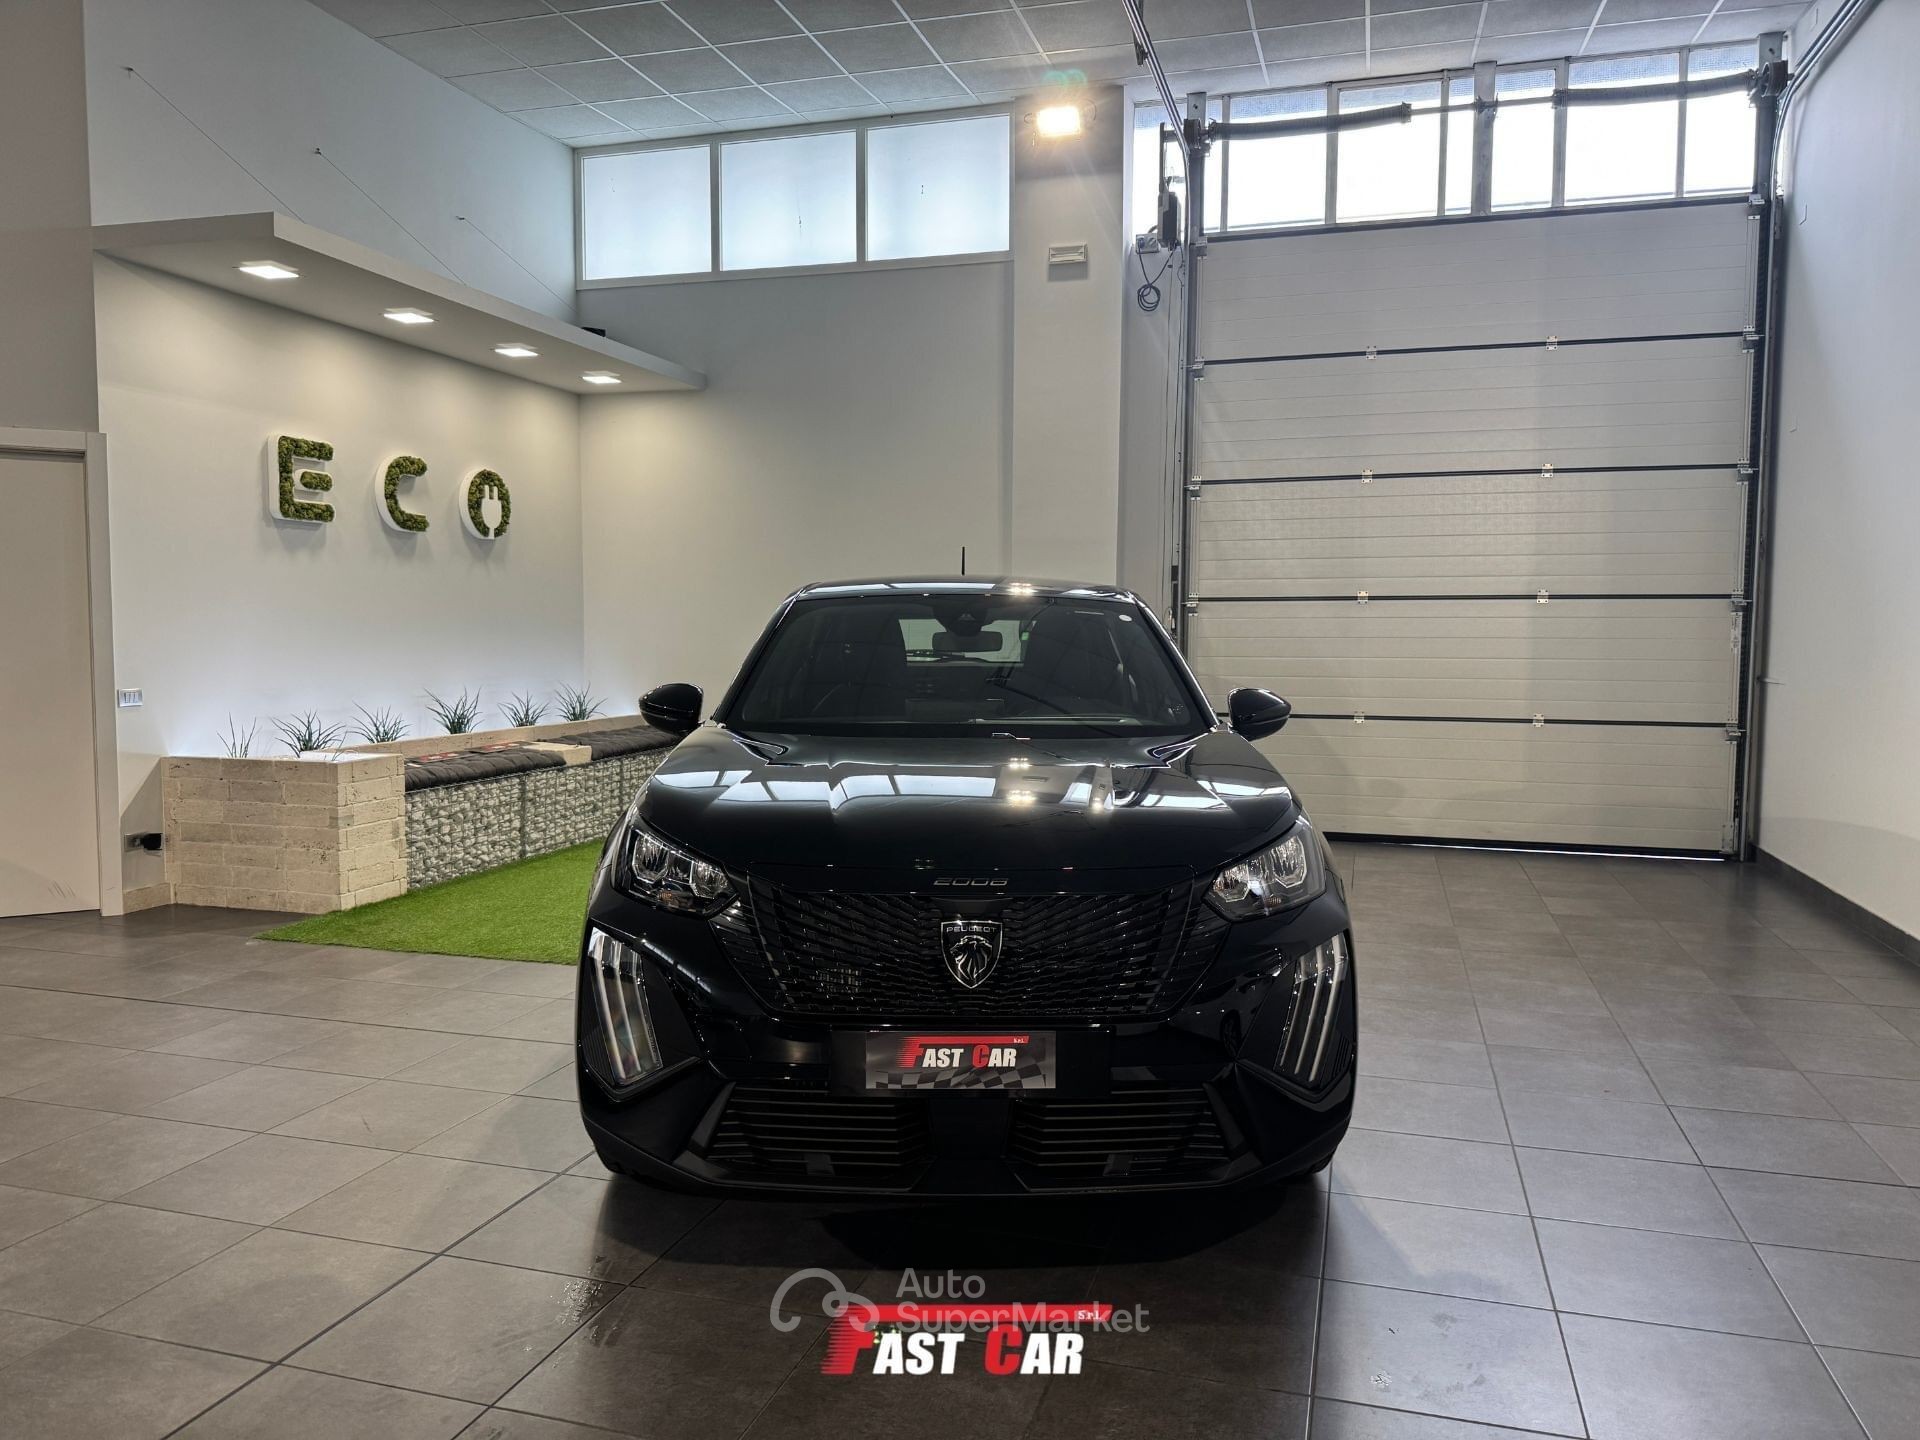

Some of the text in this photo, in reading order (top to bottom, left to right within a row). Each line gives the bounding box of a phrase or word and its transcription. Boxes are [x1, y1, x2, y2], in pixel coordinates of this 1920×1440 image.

[268, 434, 511, 540] ECO
[933, 877, 1008, 886] 2008
[946, 924, 996, 933] PEUGEOT
[896, 1036, 1017, 1068] FAST CAR
